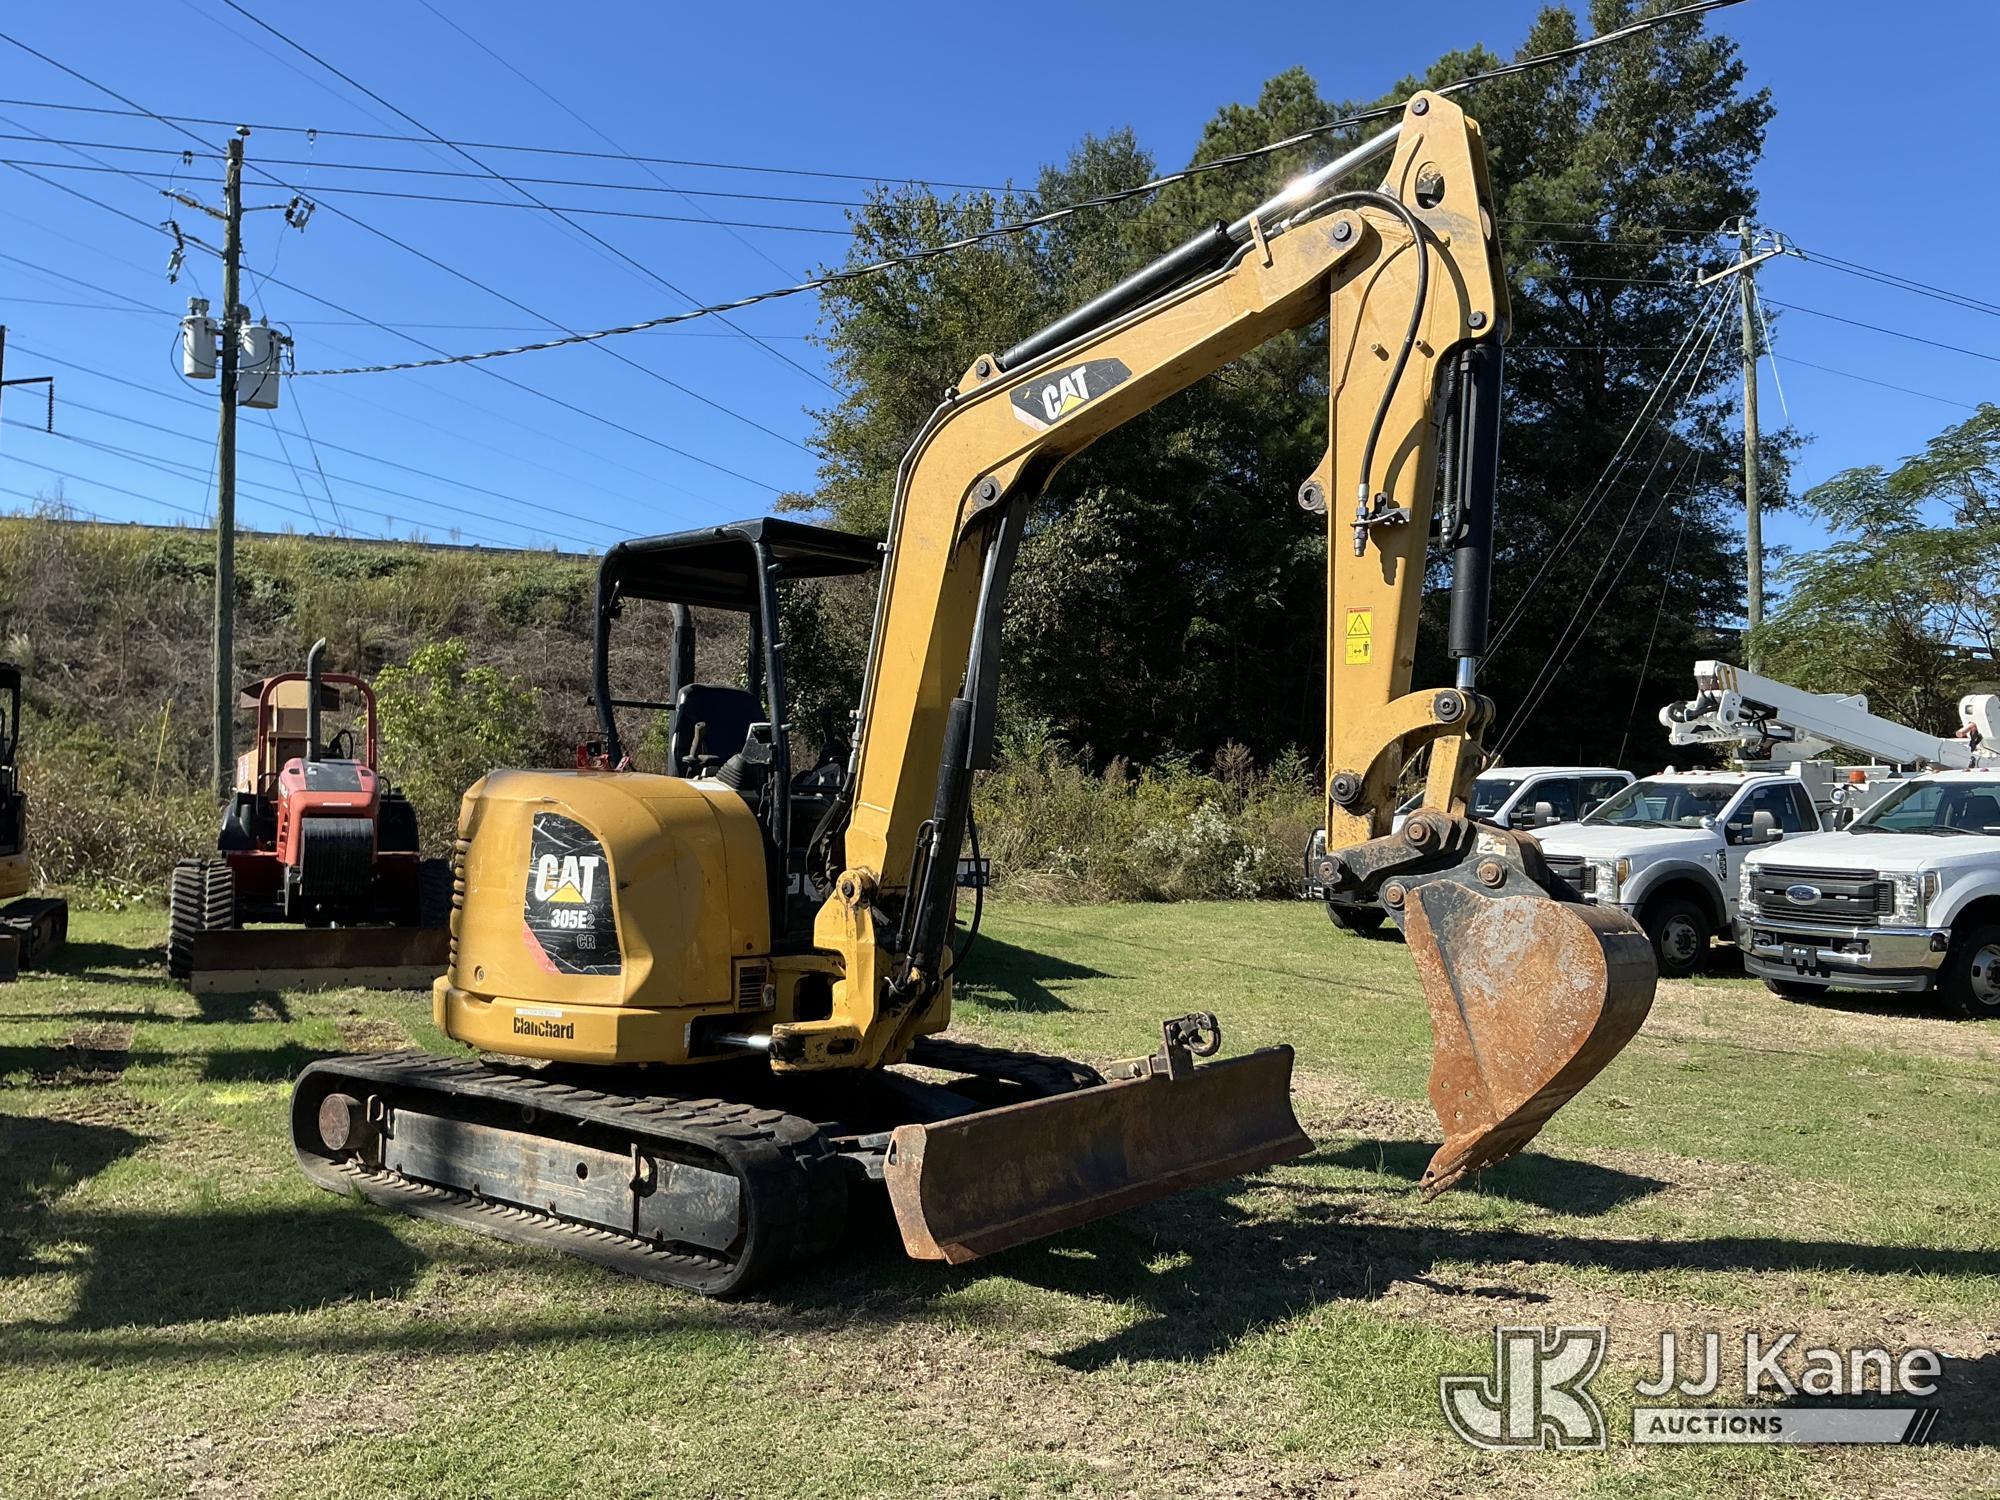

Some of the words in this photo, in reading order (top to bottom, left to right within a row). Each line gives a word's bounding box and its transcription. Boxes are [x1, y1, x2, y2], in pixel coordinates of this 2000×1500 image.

[1042, 366, 1089, 419] CAT
[535, 854, 599, 903] CAT
[577, 934, 595, 949] CR
